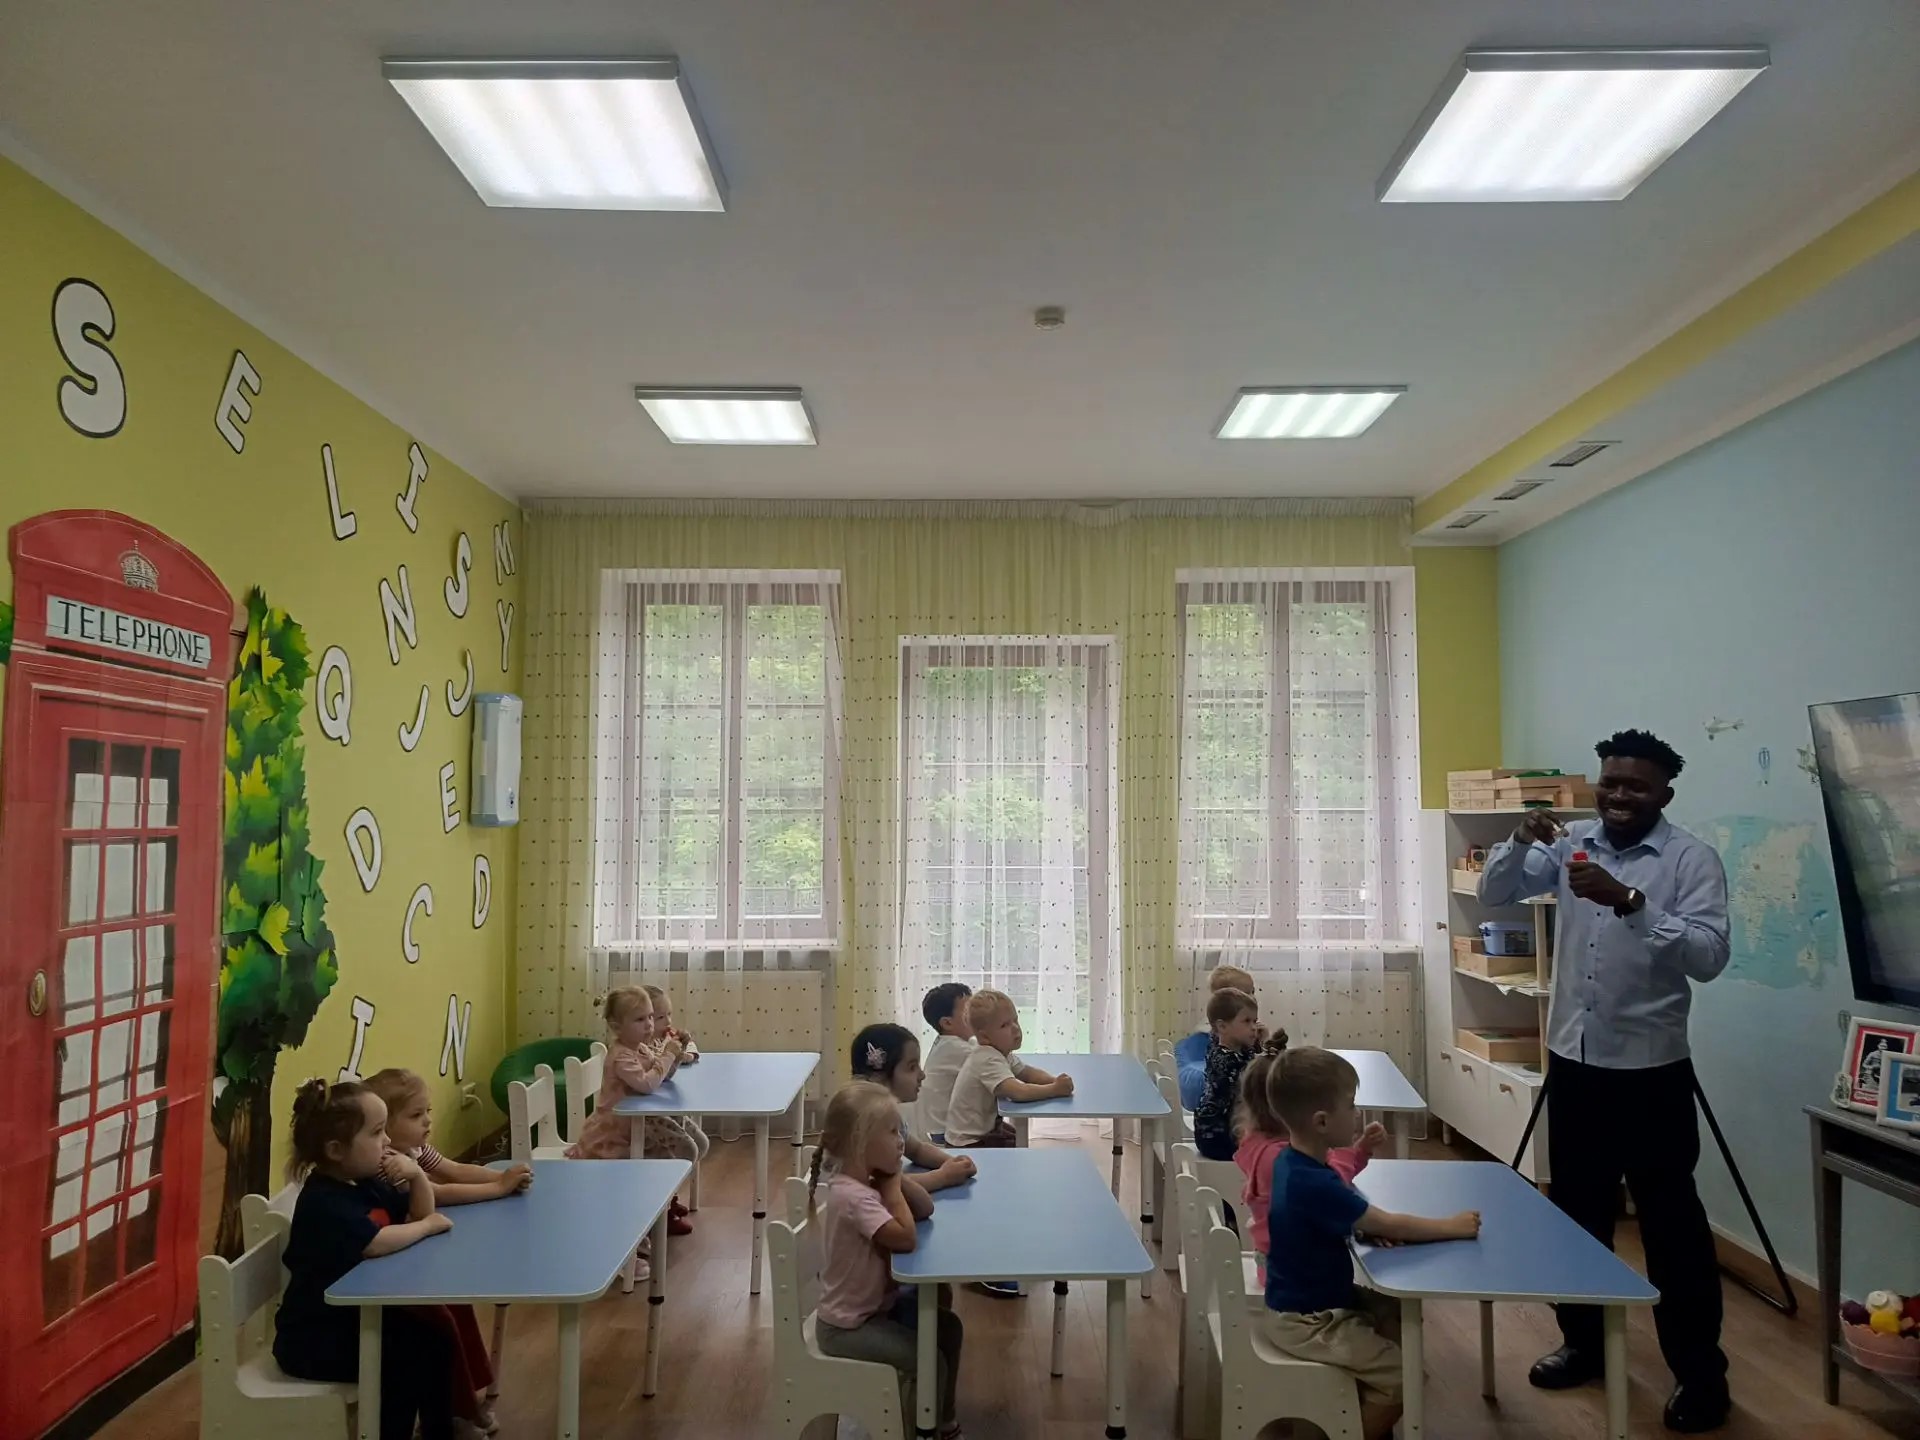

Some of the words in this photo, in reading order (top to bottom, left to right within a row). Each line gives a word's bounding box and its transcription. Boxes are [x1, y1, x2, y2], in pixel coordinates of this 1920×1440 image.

[51, 277, 127, 438] S
[214, 349, 262, 454] E
[321, 442, 358, 541] L
[444, 532, 472, 619] S
[493, 520, 516, 585] M
[58, 600, 205, 664] TELEPHONE
[379, 564, 418, 665] N
[496, 598, 515, 672] Y
[316, 645, 352, 746] Q
[398, 684, 429, 752] J
[445, 649, 475, 717] J
[439, 760, 461, 834] E
[344, 806, 383, 893] D
[472, 854, 492, 929] D
[401, 882, 433, 964] C
[439, 993, 471, 1081] N
